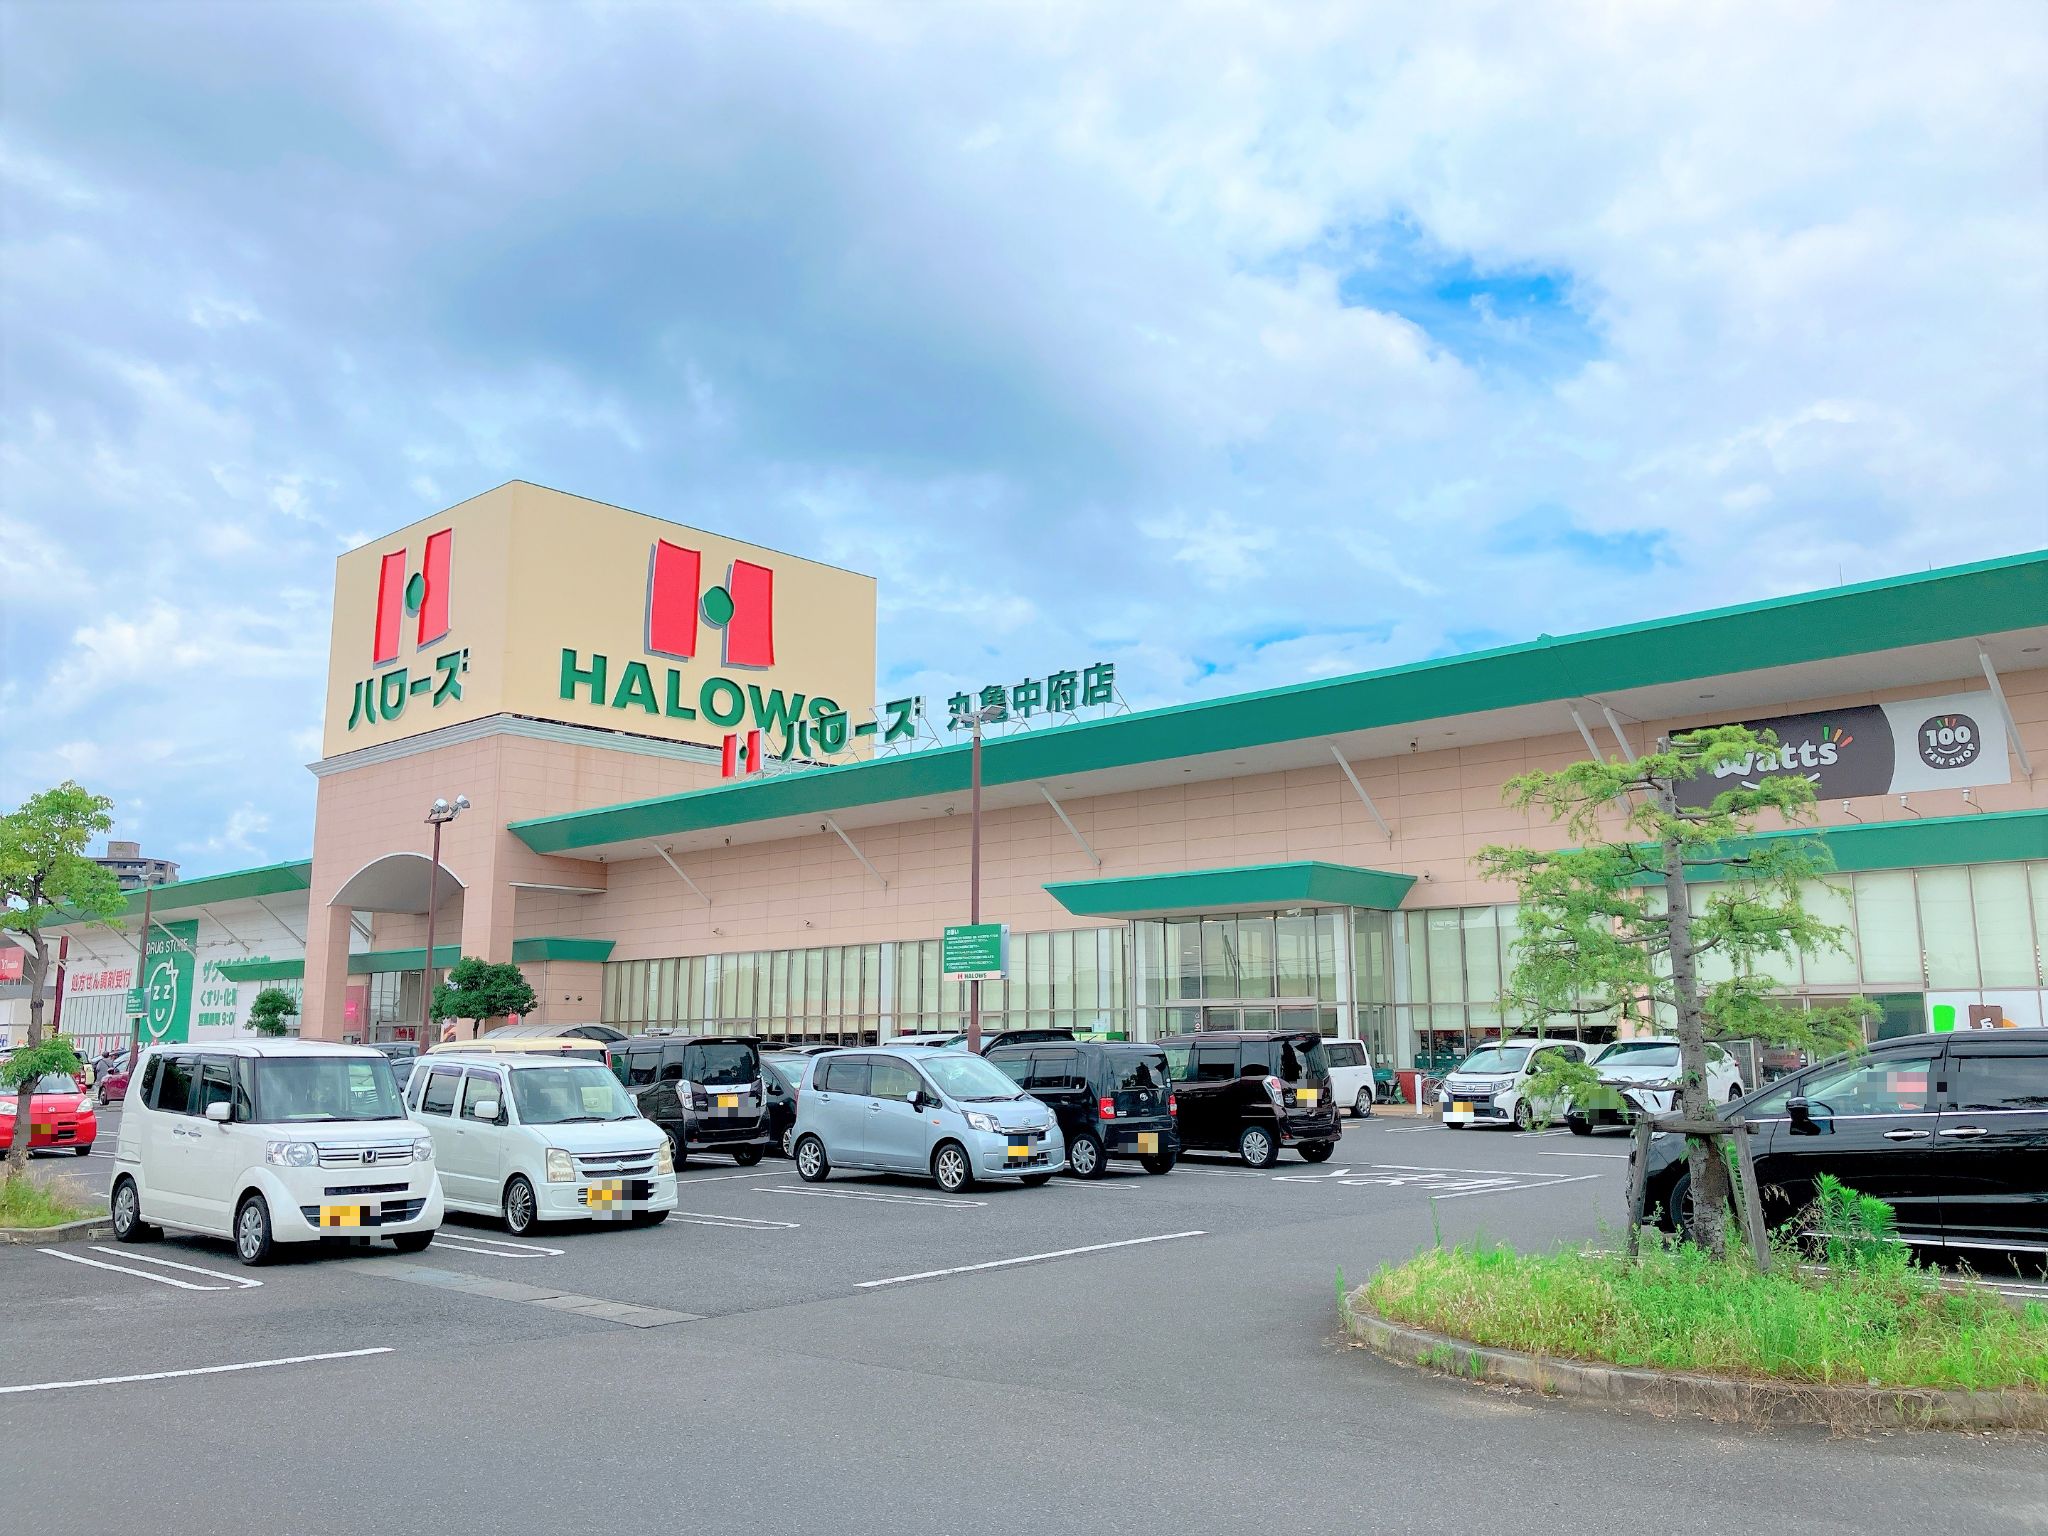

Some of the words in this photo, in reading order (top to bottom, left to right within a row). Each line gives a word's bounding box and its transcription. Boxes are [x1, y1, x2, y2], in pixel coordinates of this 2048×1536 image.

[348, 647, 469, 732] ハローズ
[559, 647, 842, 744] HALOWS
[781, 695, 926, 764] ハローズ
[1925, 725, 1971, 747] 100
[1924, 747, 1946, 766] YEN
[1948, 743, 1976, 766] SHOP
[146, 941, 164, 955] DRUG
[165, 938, 189, 953] STE
